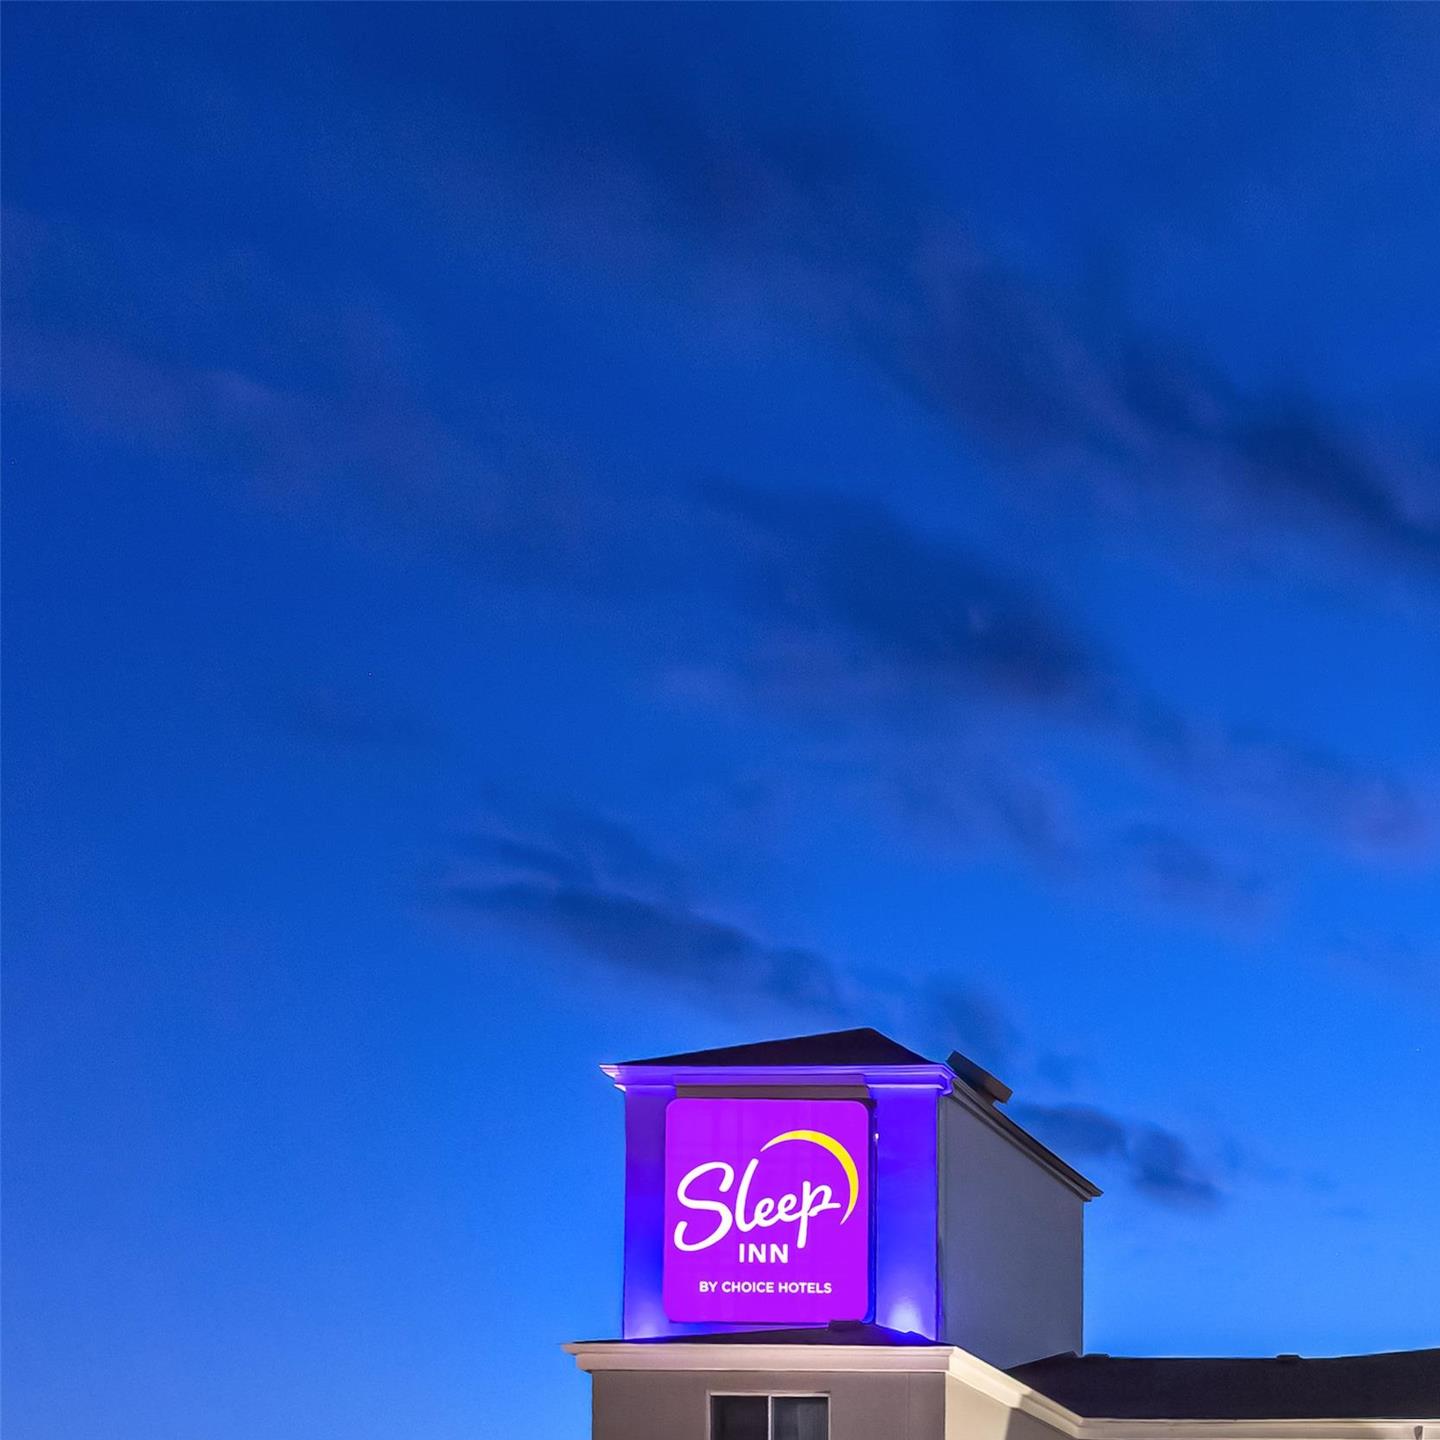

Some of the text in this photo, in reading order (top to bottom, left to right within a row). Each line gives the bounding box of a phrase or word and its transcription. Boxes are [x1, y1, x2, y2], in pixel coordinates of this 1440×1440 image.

[674, 1158, 841, 1252] Sleep
[738, 1243, 789, 1264] INN
[699, 1281, 833, 1294] BY CHOICE HOTELS
